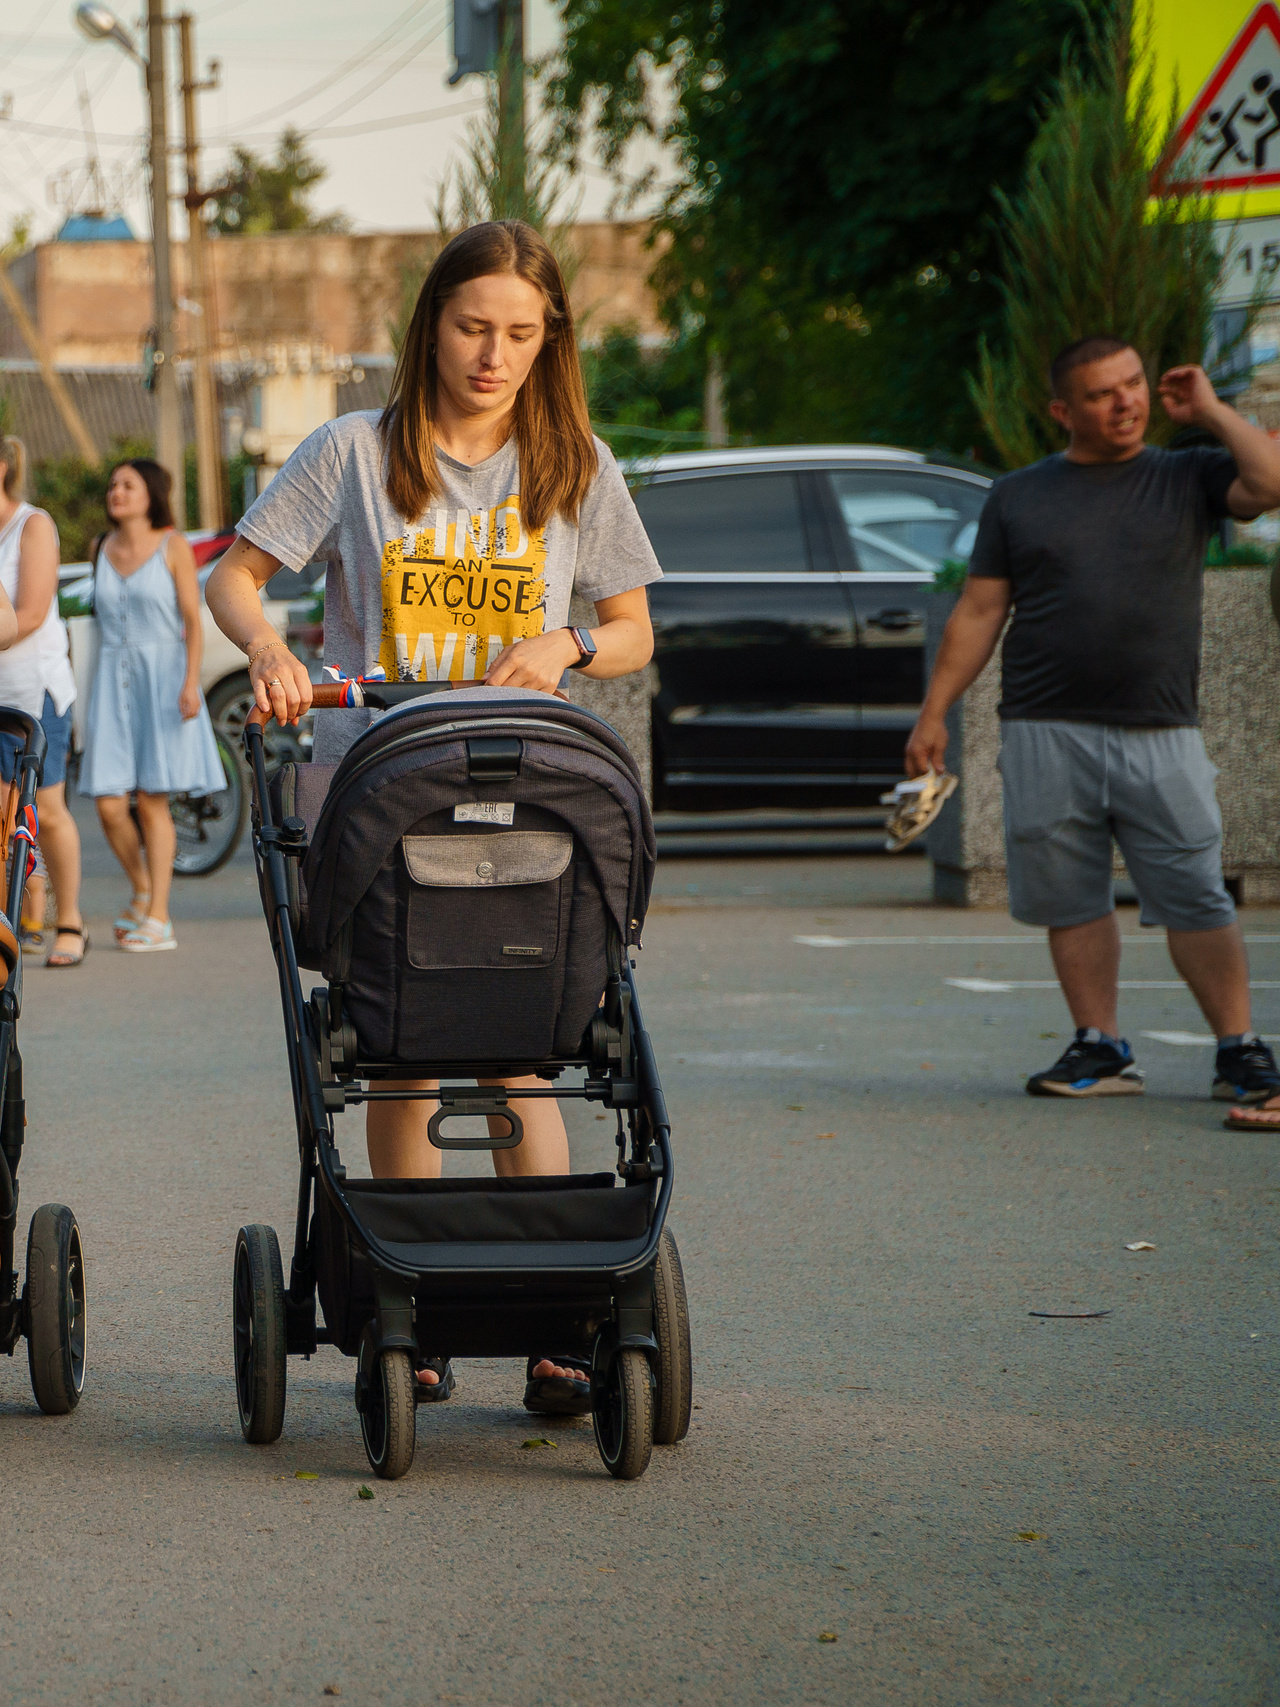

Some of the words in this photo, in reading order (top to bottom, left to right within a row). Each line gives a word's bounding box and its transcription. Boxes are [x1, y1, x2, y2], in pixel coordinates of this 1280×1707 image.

[402, 506, 529, 560] FIND
[453, 559, 483, 573] AN
[400, 571, 531, 615] EXCUSE
[451, 612, 476, 627] TO
